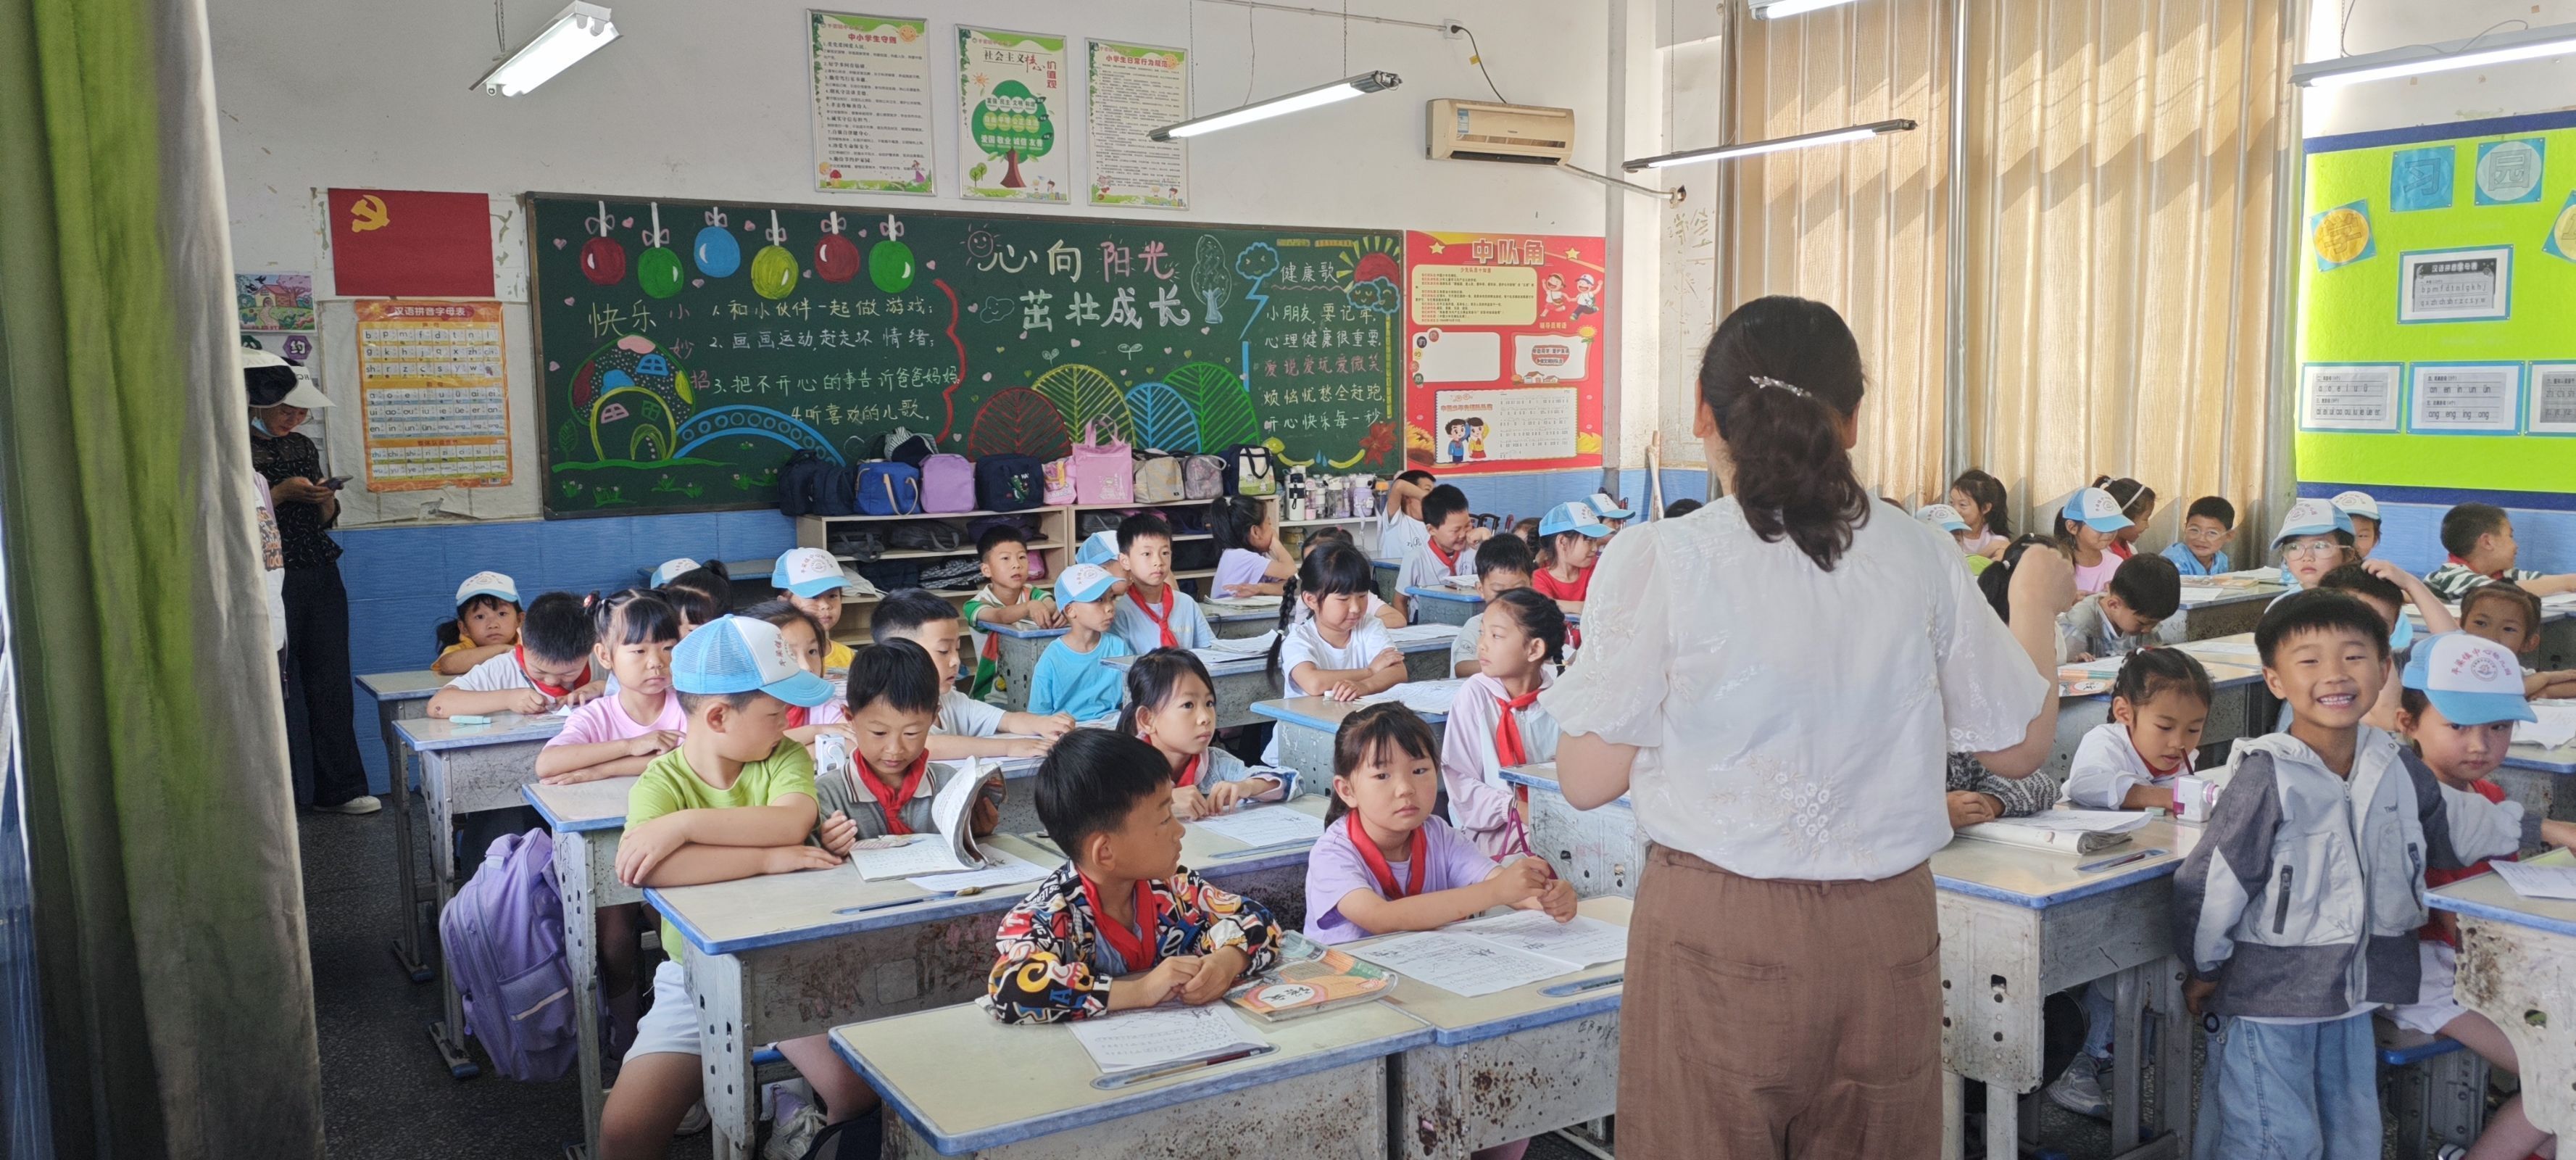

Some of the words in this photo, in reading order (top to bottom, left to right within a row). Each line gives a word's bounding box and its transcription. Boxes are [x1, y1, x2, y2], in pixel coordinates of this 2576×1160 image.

[848, 33, 897, 44] 中小学生守则
[984, 50, 1024, 63] 社会主义
[1106, 54, 1168, 67] 小学生日常行为规范
[1047, 61, 1057, 89] 价值观
[2403, 157, 2441, 196] 习
[2488, 149, 2532, 191] 园
[1471, 239, 1545, 266] 中队角
[977, 239, 1176, 283] 心向阳光
[1280, 261, 1339, 283] 健康歌
[394, 306, 465, 317] 汉语拼音字母表
[1019, 285, 1190, 333] 茁壮成长
[365, 331, 371, 339] b
[589, 299, 657, 339] 快乐
[669, 303, 712, 391] 小妙招
[366, 365, 375, 373] sh
[2428, 411, 2440, 420] ang
[2446, 411, 2456, 420] eng
[2463, 410, 2472, 420] ing
[2477, 411, 2489, 420] ong
[422, 423, 432, 431] ün
